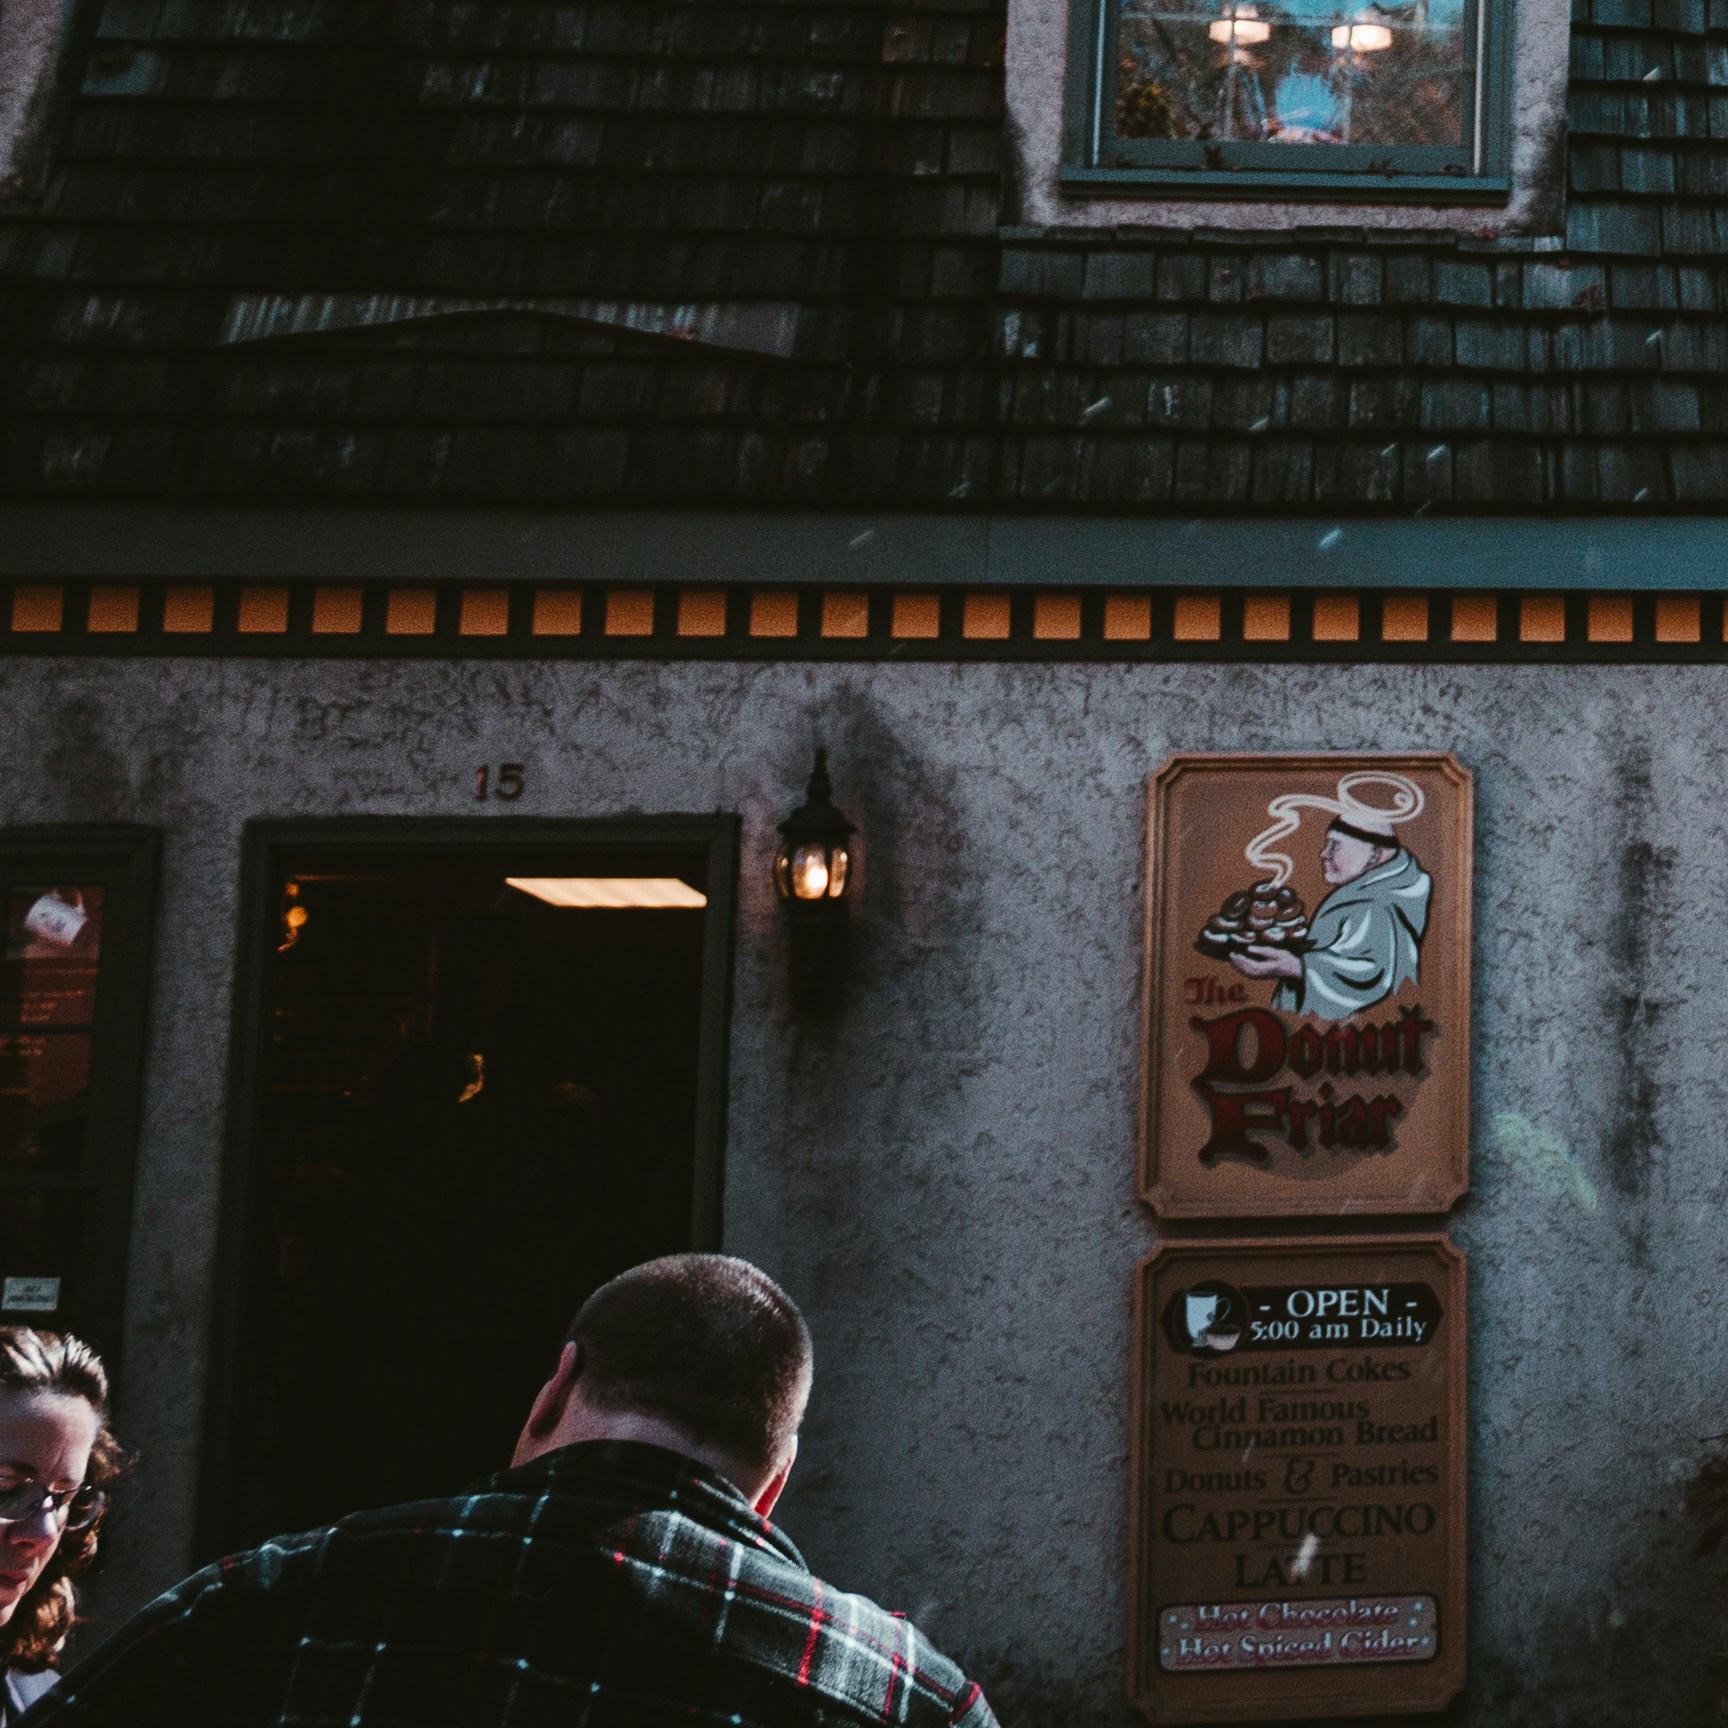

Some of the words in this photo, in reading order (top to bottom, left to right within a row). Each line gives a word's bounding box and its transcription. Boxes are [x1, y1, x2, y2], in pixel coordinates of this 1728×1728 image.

[475, 762, 524, 801] 15
[1183, 975, 1247, 1005] The
[1188, 1003, 1436, 1084] Donut
[1190, 1074, 1402, 1167] Friar
[1286, 1288, 1390, 1318] OPEN
[1250, 1320, 1300, 1341] 5:00
[1309, 1323, 1349, 1339] am
[1360, 1315, 1427, 1342] Daily
[1186, 1359, 1316, 1387] Fountain
[1325, 1356, 1412, 1383] Cokes
[1160, 1396, 1245, 1425] World
[1258, 1398, 1370, 1423] Famous
[1192, 1423, 1344, 1450] Cinnamon
[1355, 1416, 1438, 1445] Bread
[1164, 1468, 1266, 1493] Donuts
[1283, 1457, 1315, 1495] &
[1331, 1459, 1439, 1487] Pastries
[1161, 1502, 1437, 1544] CAPPUCCINO
[1234, 1553, 1367, 1589] LATE
[1197, 1604, 1249, 1632] Hot
[1259, 1599, 1398, 1629] Chocolate
[1177, 1637, 1231, 1663] Hot
[1240, 1631, 1332, 1664] Spiced
[1340, 1629, 1419, 1658] Cider
